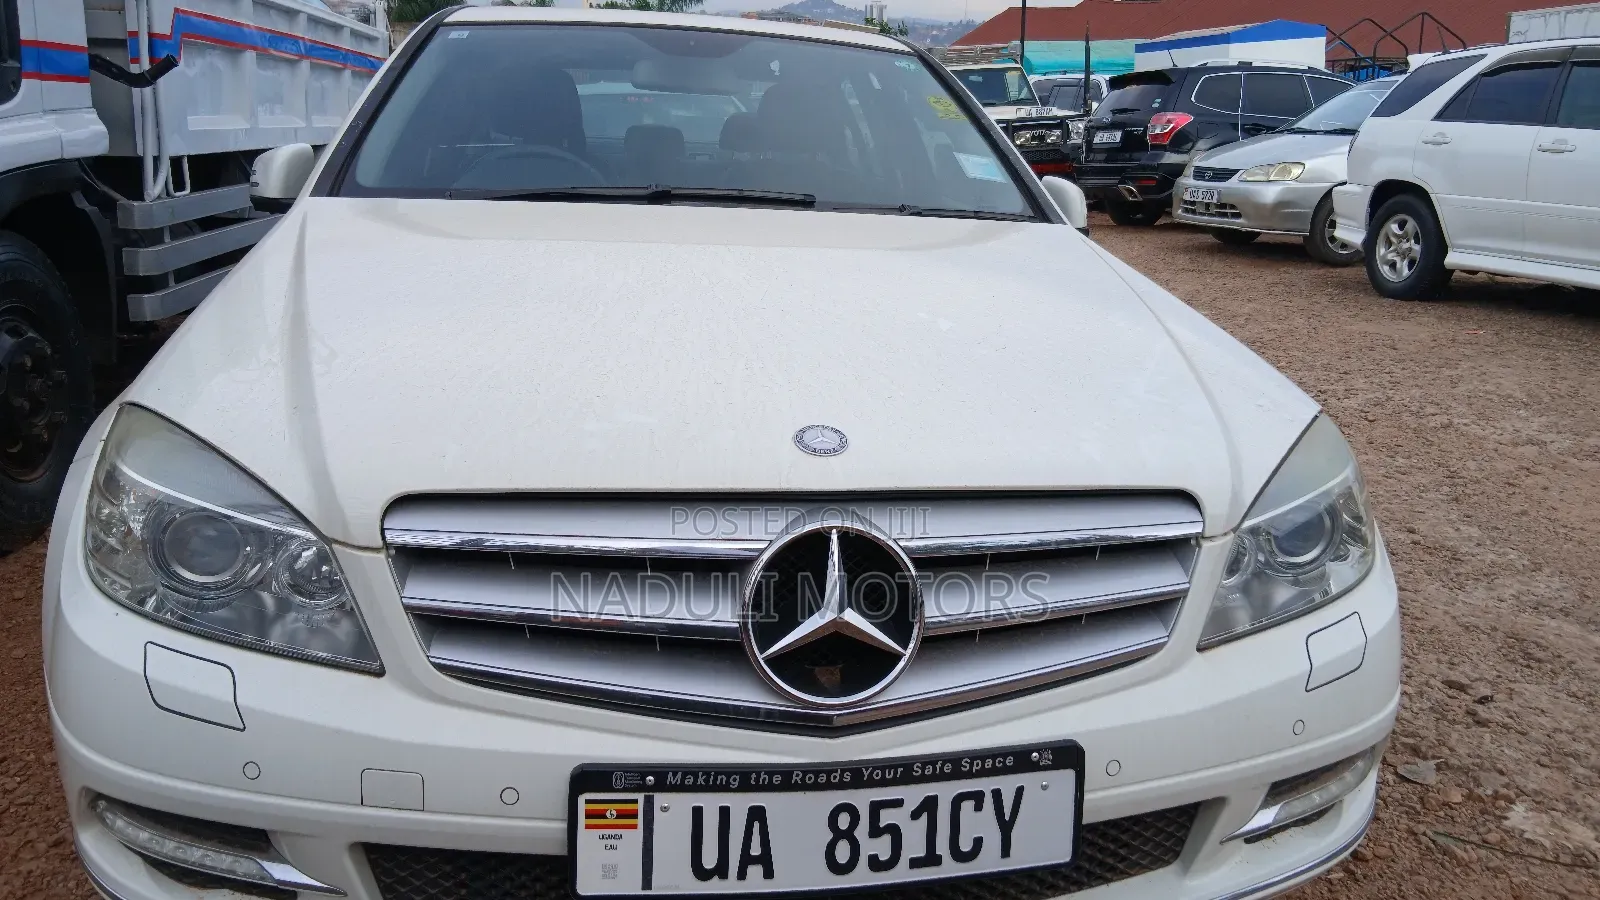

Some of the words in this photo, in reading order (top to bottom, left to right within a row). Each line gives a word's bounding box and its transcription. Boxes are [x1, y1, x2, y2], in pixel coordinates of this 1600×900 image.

[666, 771, 740, 788] Making
[750, 771, 782, 785] the
[792, 768, 852, 784] Roads
[861, 766, 904, 781] Your
[912, 760, 953, 776] Safe
[960, 755, 1014, 773] Space
[604, 843, 618, 851] EAU
[690, 804, 775, 881] UA
[824, 784, 1025, 876] 851CY
